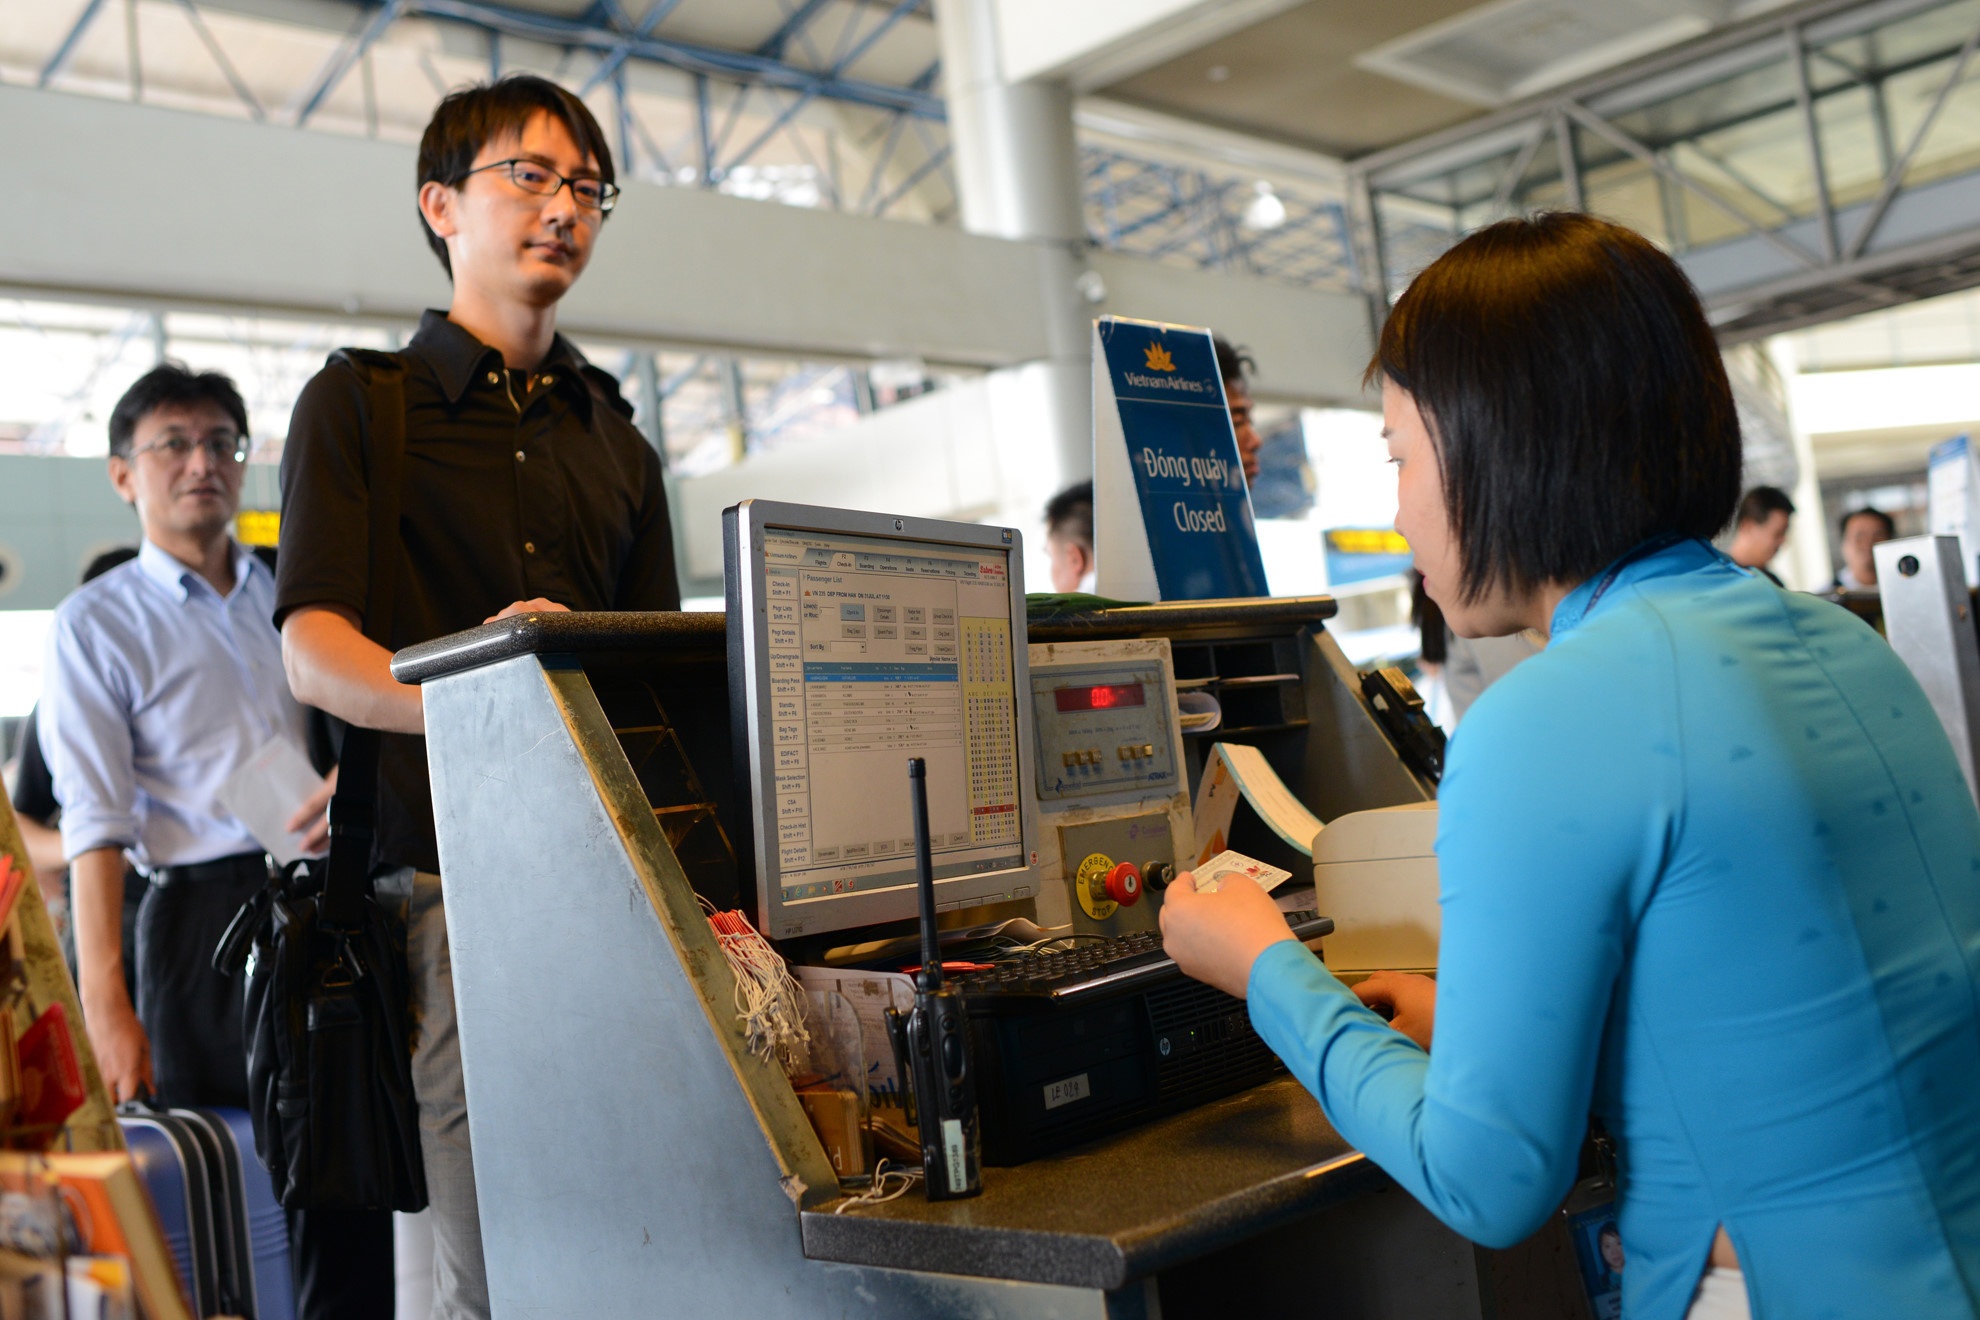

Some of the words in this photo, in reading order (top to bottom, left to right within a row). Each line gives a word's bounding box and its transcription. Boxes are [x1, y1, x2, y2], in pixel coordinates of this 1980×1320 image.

[1143, 447, 1191, 487] Đóng
[1173, 501, 1227, 532] Closed
[806, 574, 832, 583] Passenger
[771, 677, 789, 685] Boarding
[1078, 856, 1114, 885] EMERGENC
[1091, 904, 1111, 916] STOP
